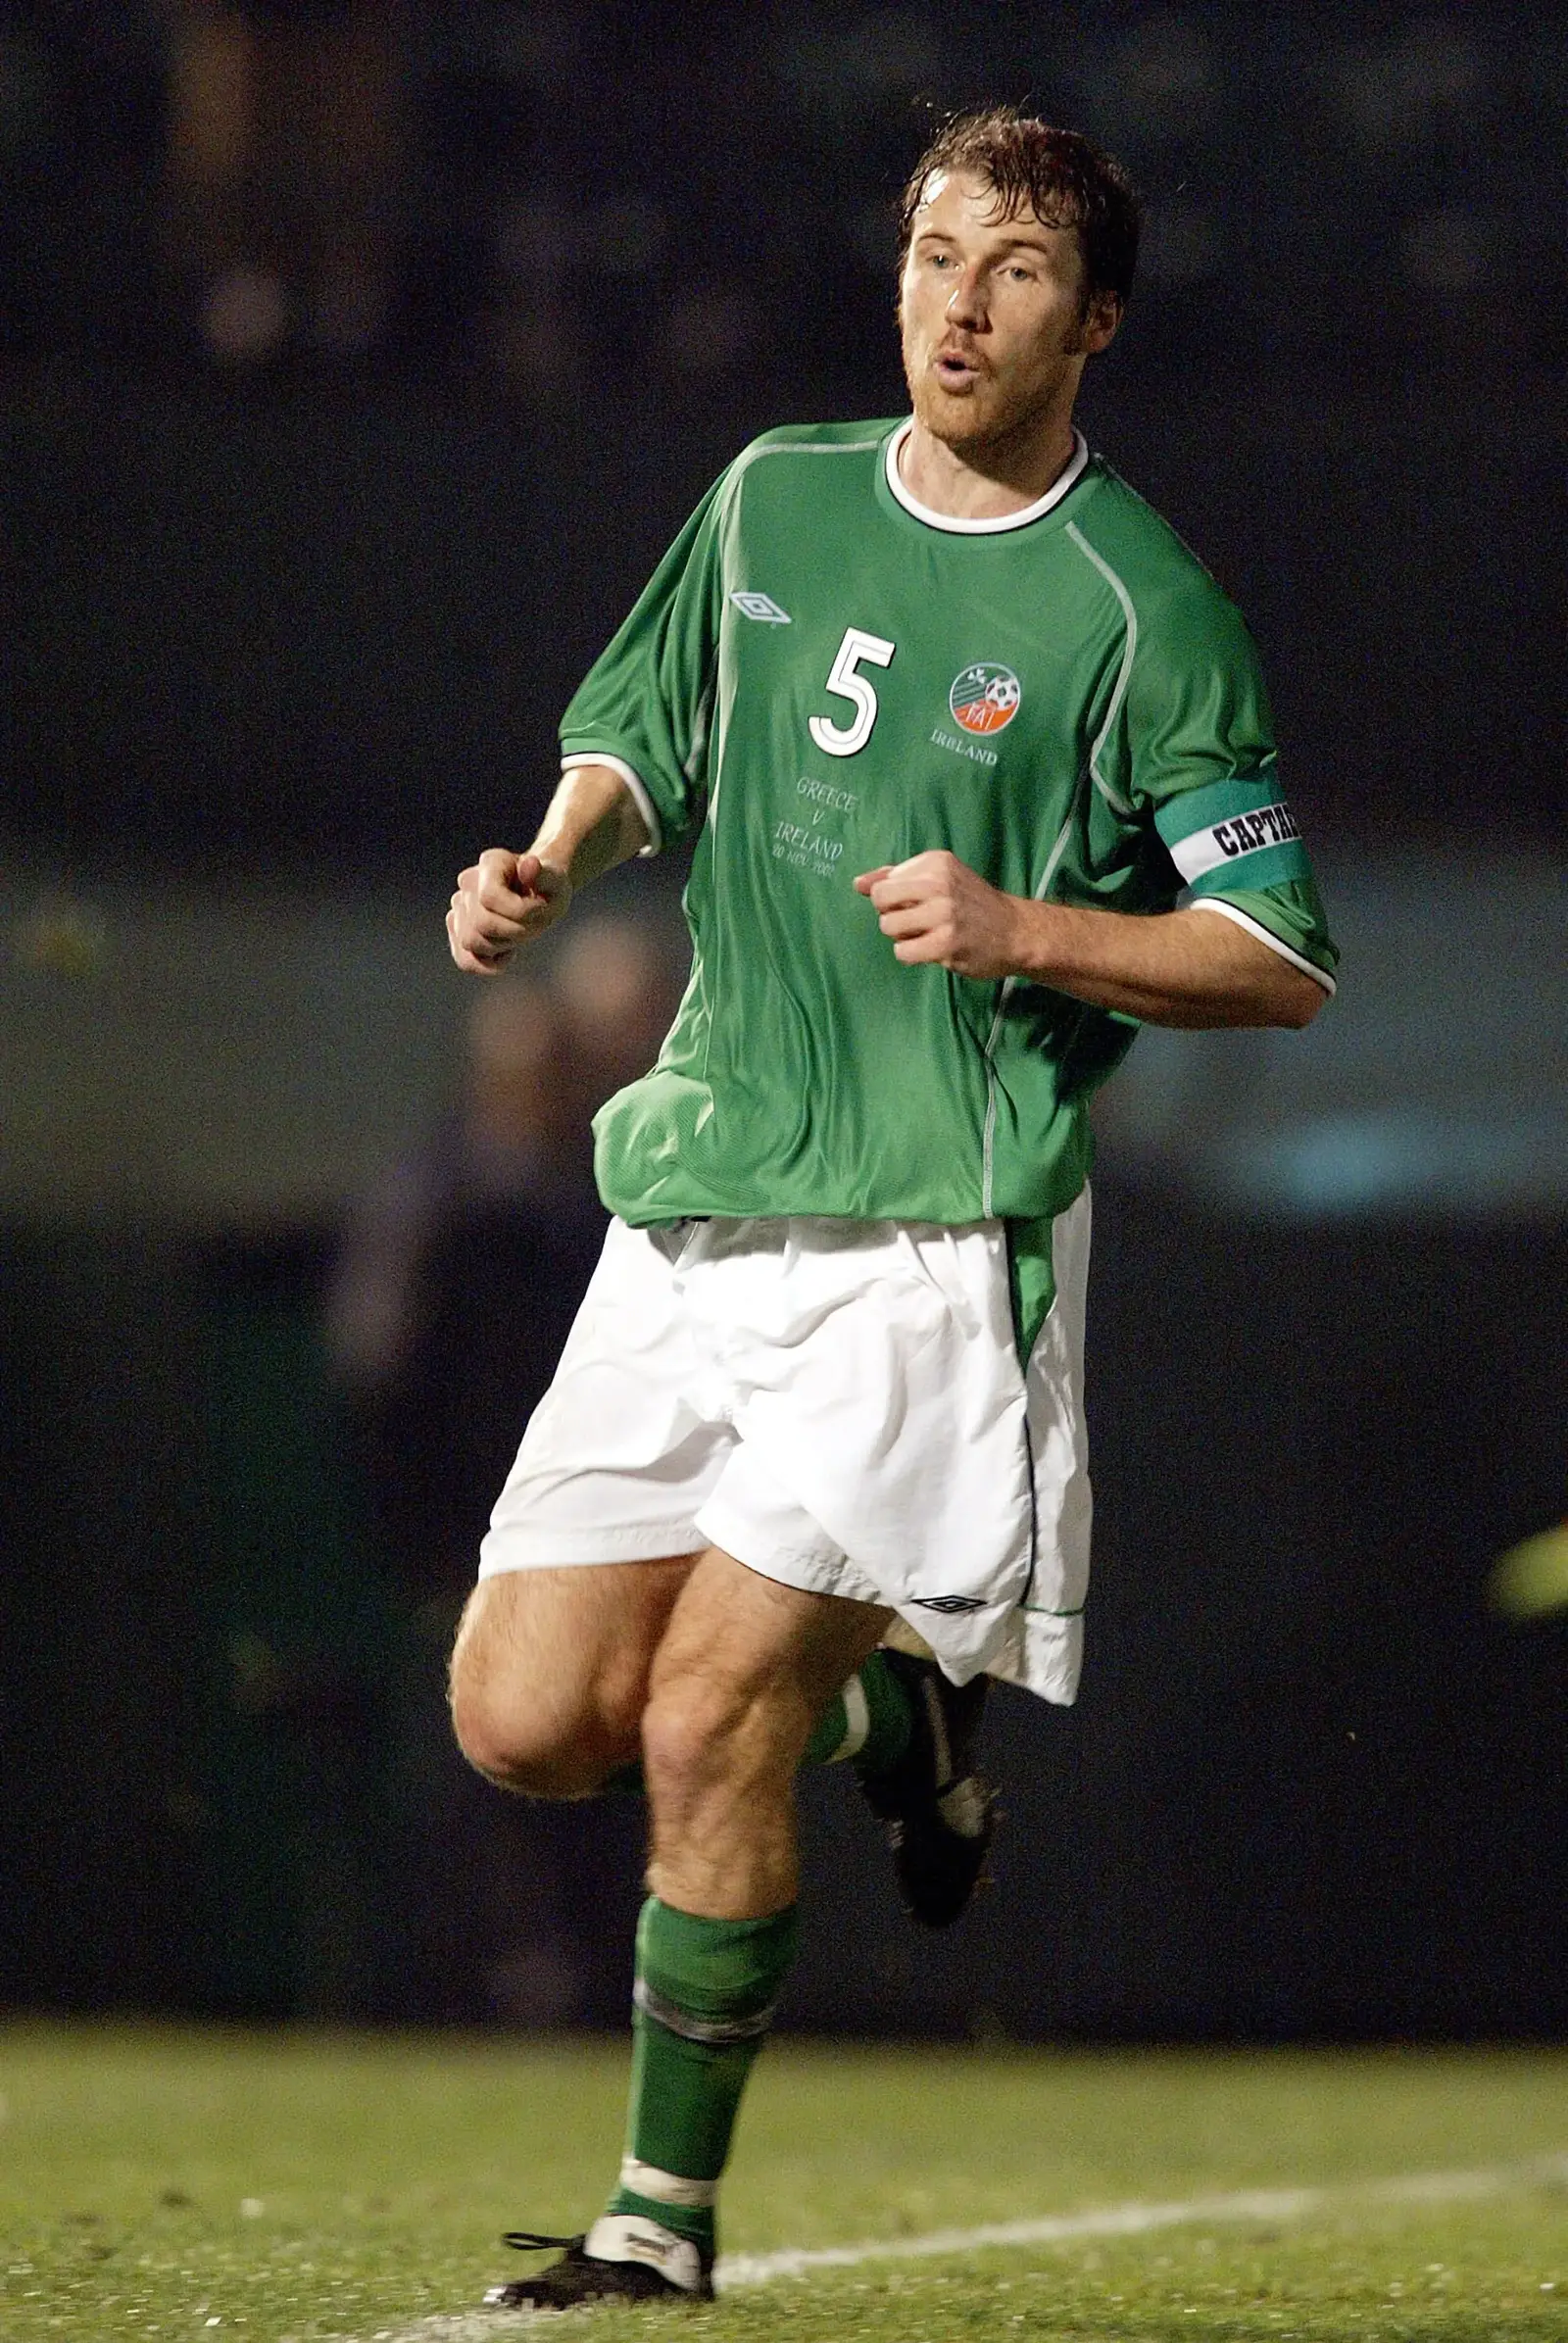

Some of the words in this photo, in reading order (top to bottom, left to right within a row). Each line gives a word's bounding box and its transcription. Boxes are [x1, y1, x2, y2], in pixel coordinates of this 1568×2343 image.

[808, 626, 896, 757] 5
[931, 729, 998, 766] IRELAND
[797, 776, 858, 812] GREECE
[773, 821, 843, 861] IRELAND
